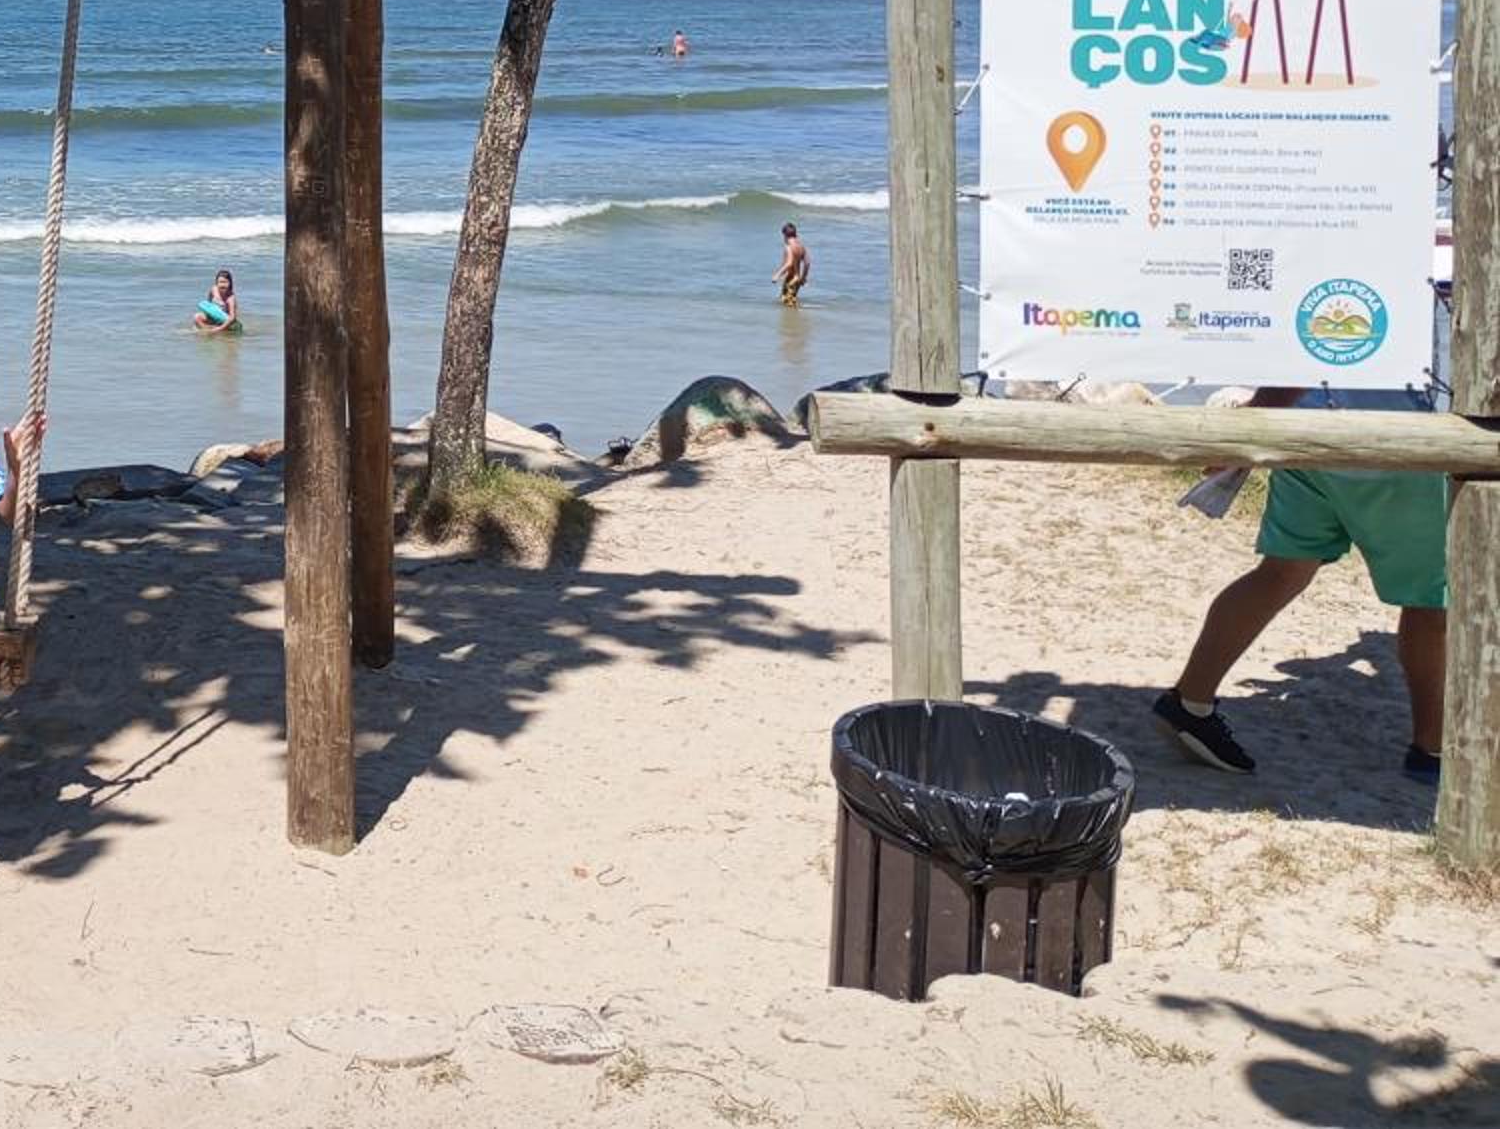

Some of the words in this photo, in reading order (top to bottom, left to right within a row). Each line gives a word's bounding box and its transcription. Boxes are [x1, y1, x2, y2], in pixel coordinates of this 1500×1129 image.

[1070, 33, 1228, 89] ÇOS
[1023, 302, 1141, 335] Itapema
[1199, 311, 1271, 330] Itapema
